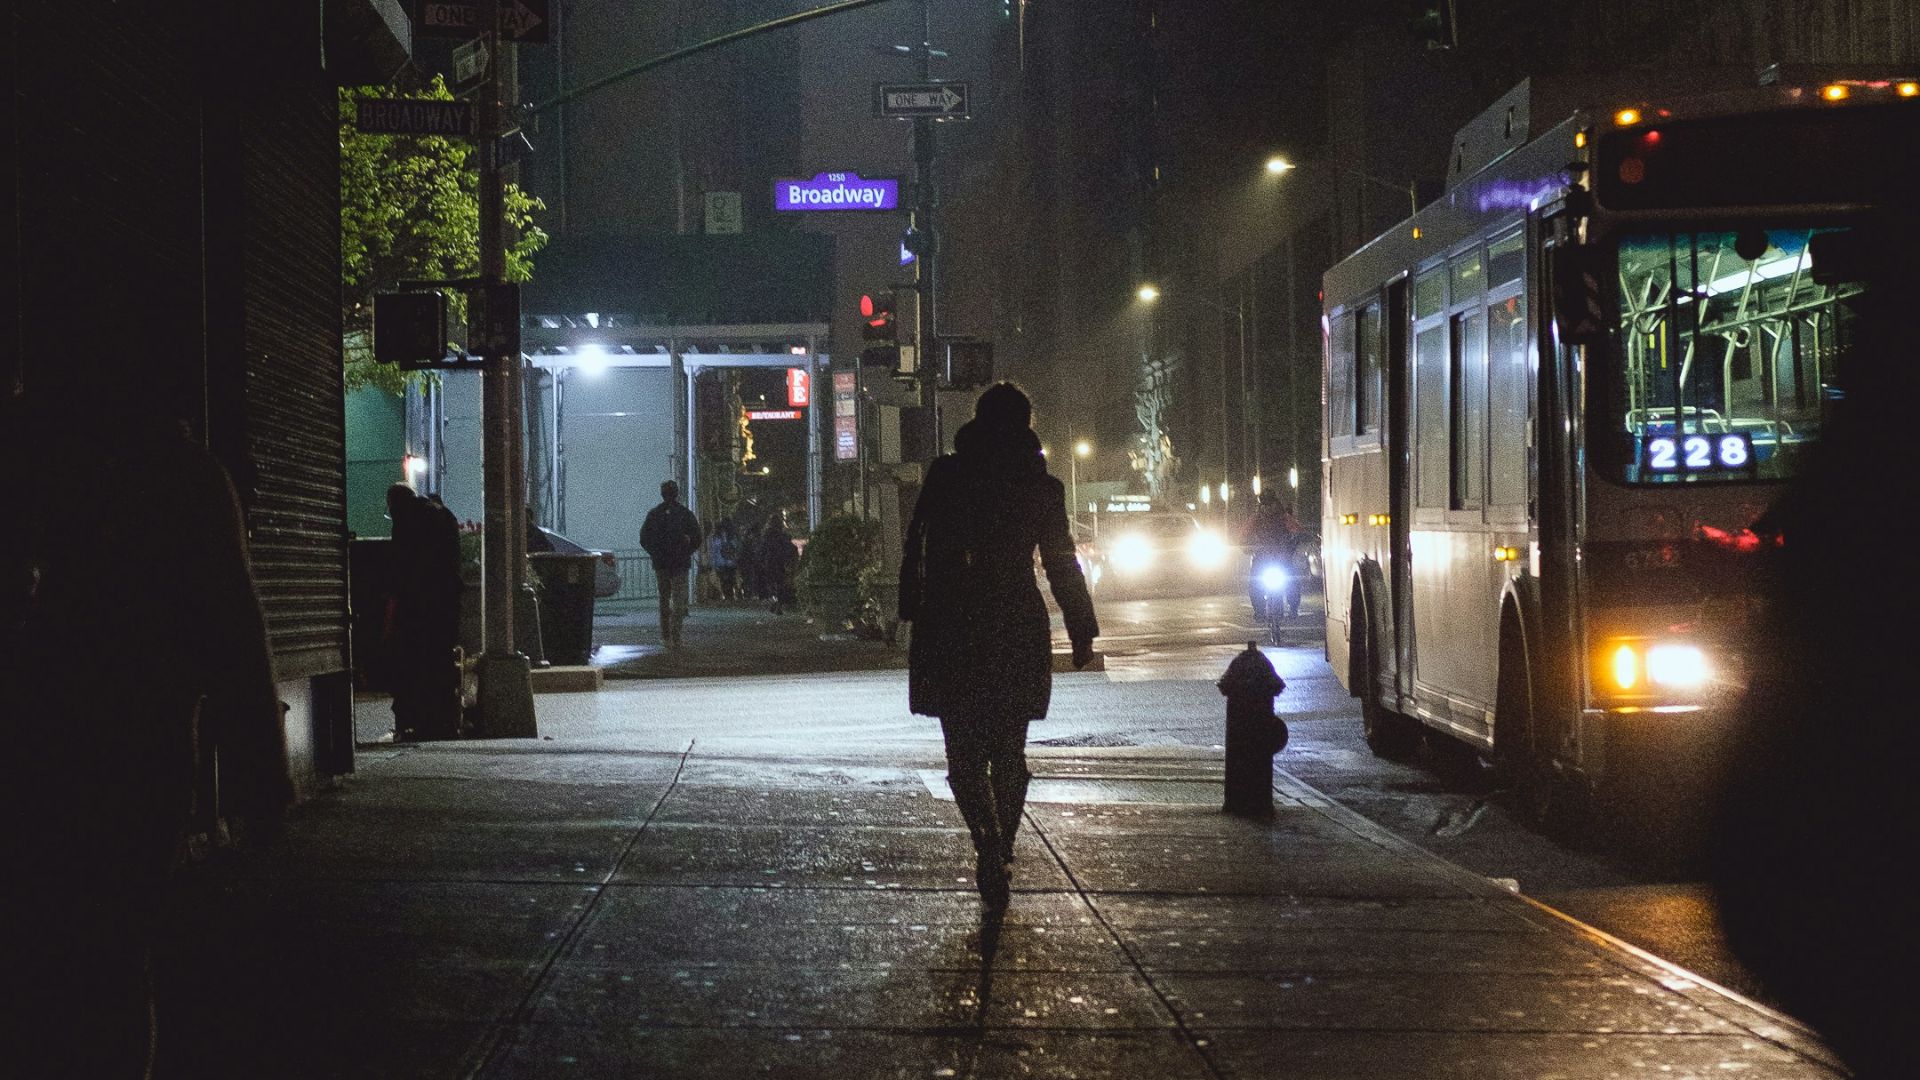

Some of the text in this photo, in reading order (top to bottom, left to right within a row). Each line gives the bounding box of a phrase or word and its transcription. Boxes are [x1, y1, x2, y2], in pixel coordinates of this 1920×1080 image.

[895, 92, 954, 106] ONE WAY
[362, 103, 465, 132] BROADWAY
[828, 173, 846, 182] 1250
[789, 183, 885, 208] Broadway
[1649, 436, 1748, 468] 228
